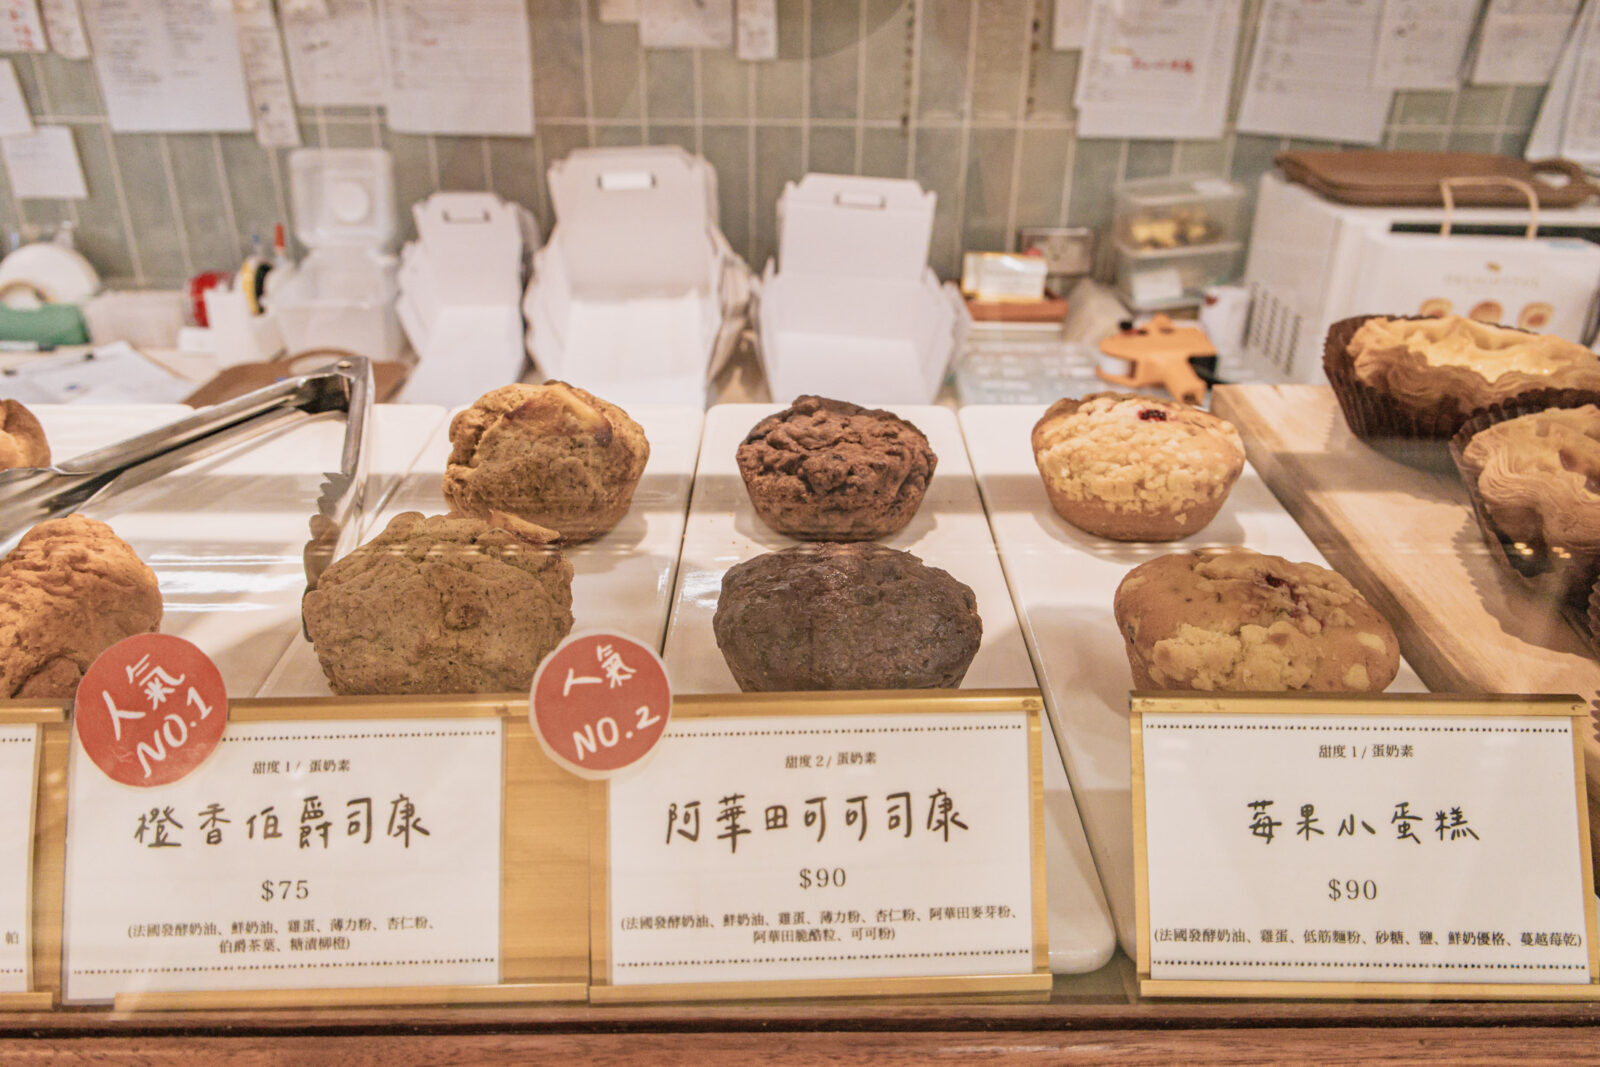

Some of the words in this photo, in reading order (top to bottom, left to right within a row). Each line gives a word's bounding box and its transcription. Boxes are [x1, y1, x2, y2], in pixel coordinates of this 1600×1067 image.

[563, 644, 638, 698] 人氣
[101, 652, 186, 742] 人氣
[136, 685, 213, 779] NO.1
[572, 705, 661, 761] NO.2
[1318, 743, 1347, 760] 甜度
[1372, 743, 1414, 760] 蛋奶素
[252, 760, 281, 775] 甜度
[309, 758, 350, 774] 蛋奶素
[784, 754, 812, 769] 甜度
[836, 751, 877, 768] 蛋奶素
[134, 793, 431, 849] 橙香伯爵司康
[665, 787, 970, 855] 阿華田可可司康
[1246, 799, 1481, 846] 莓果小蛋糕
[260, 879, 310, 903] $75
[799, 867, 847, 891] $90
[1327, 877, 1378, 902] $90
